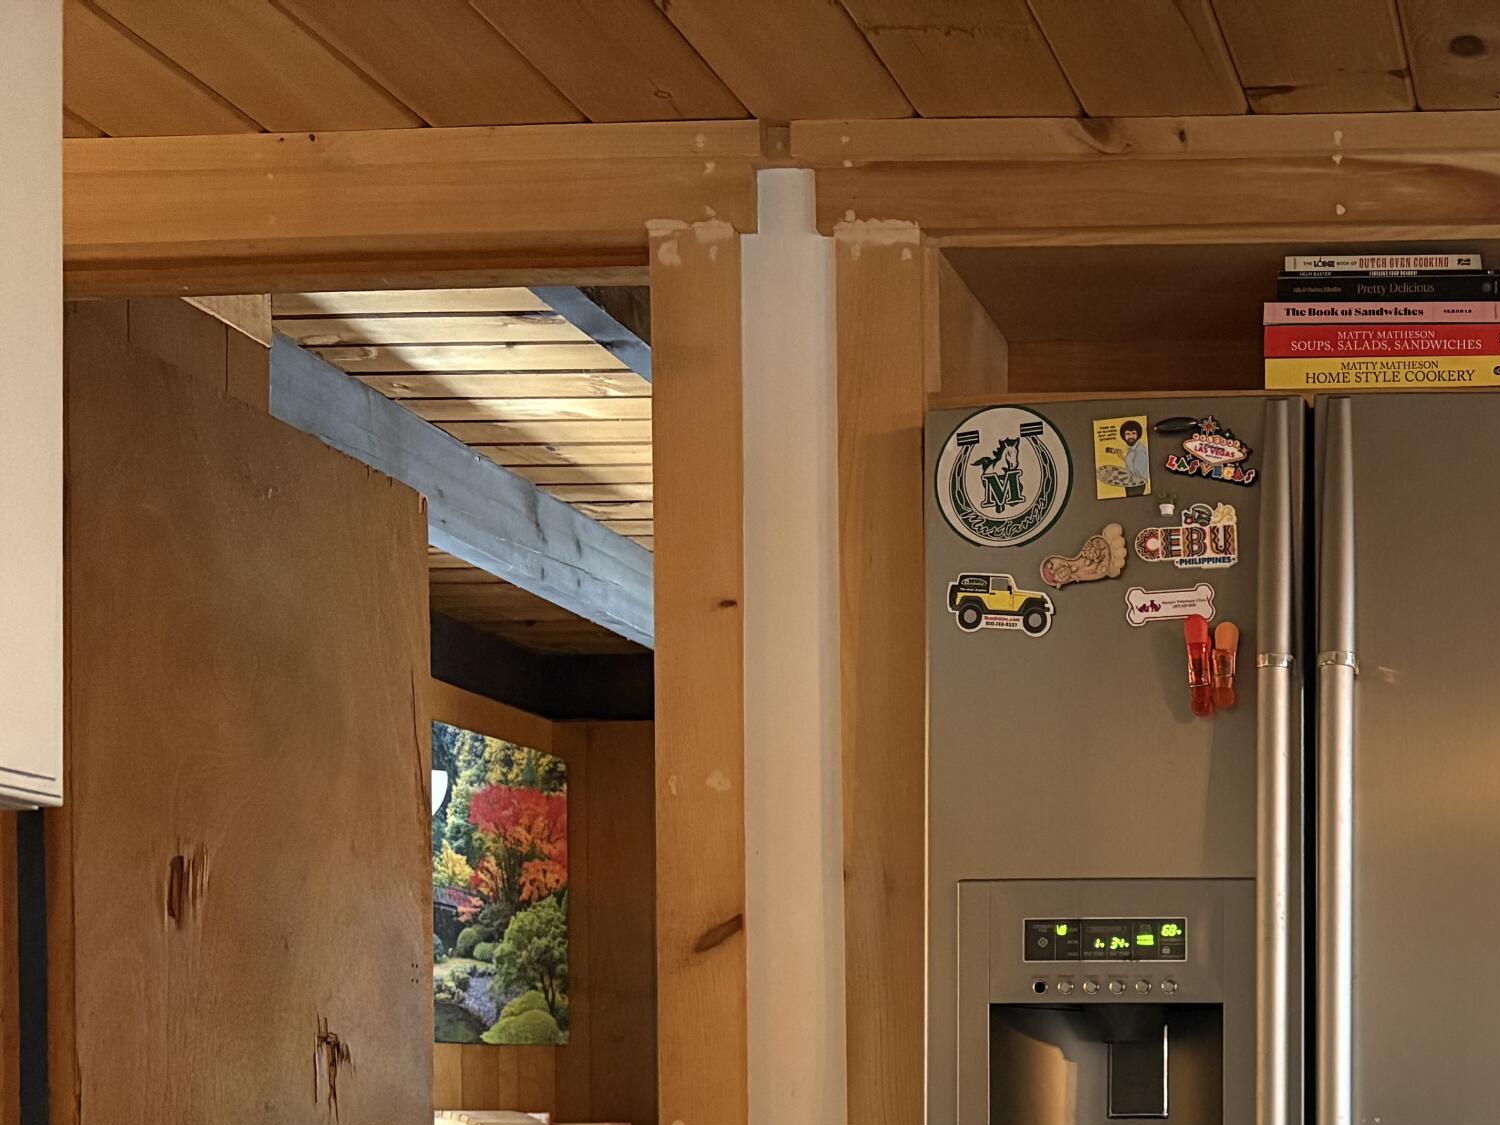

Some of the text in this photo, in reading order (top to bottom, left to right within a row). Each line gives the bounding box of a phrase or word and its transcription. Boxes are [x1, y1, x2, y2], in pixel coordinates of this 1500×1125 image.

[1359, 258, 1387, 269] DUTCH
[1390, 257, 1411, 268] OVEN
[1413, 257, 1449, 268] COOKING
[1357, 282, 1435, 295] Pretty Delicious
[1284, 307, 1424, 317] The Book of Sandwiches
[1337, 330, 1435, 340] MATTY MATHESON
[1291, 339, 1482, 352] SOUPS, SALADS, SANDWICHES
[1341, 360, 1439, 371] MATTY MATHESON
[1305, 369, 1476, 384] HOME STYLE COOKERY
[1166, 455, 1200, 475] LAS
[981, 469, 1026, 508] M
[1136, 525, 1236, 561] CEBU
[1179, 556, 1232, 566] PHILIPPINES
